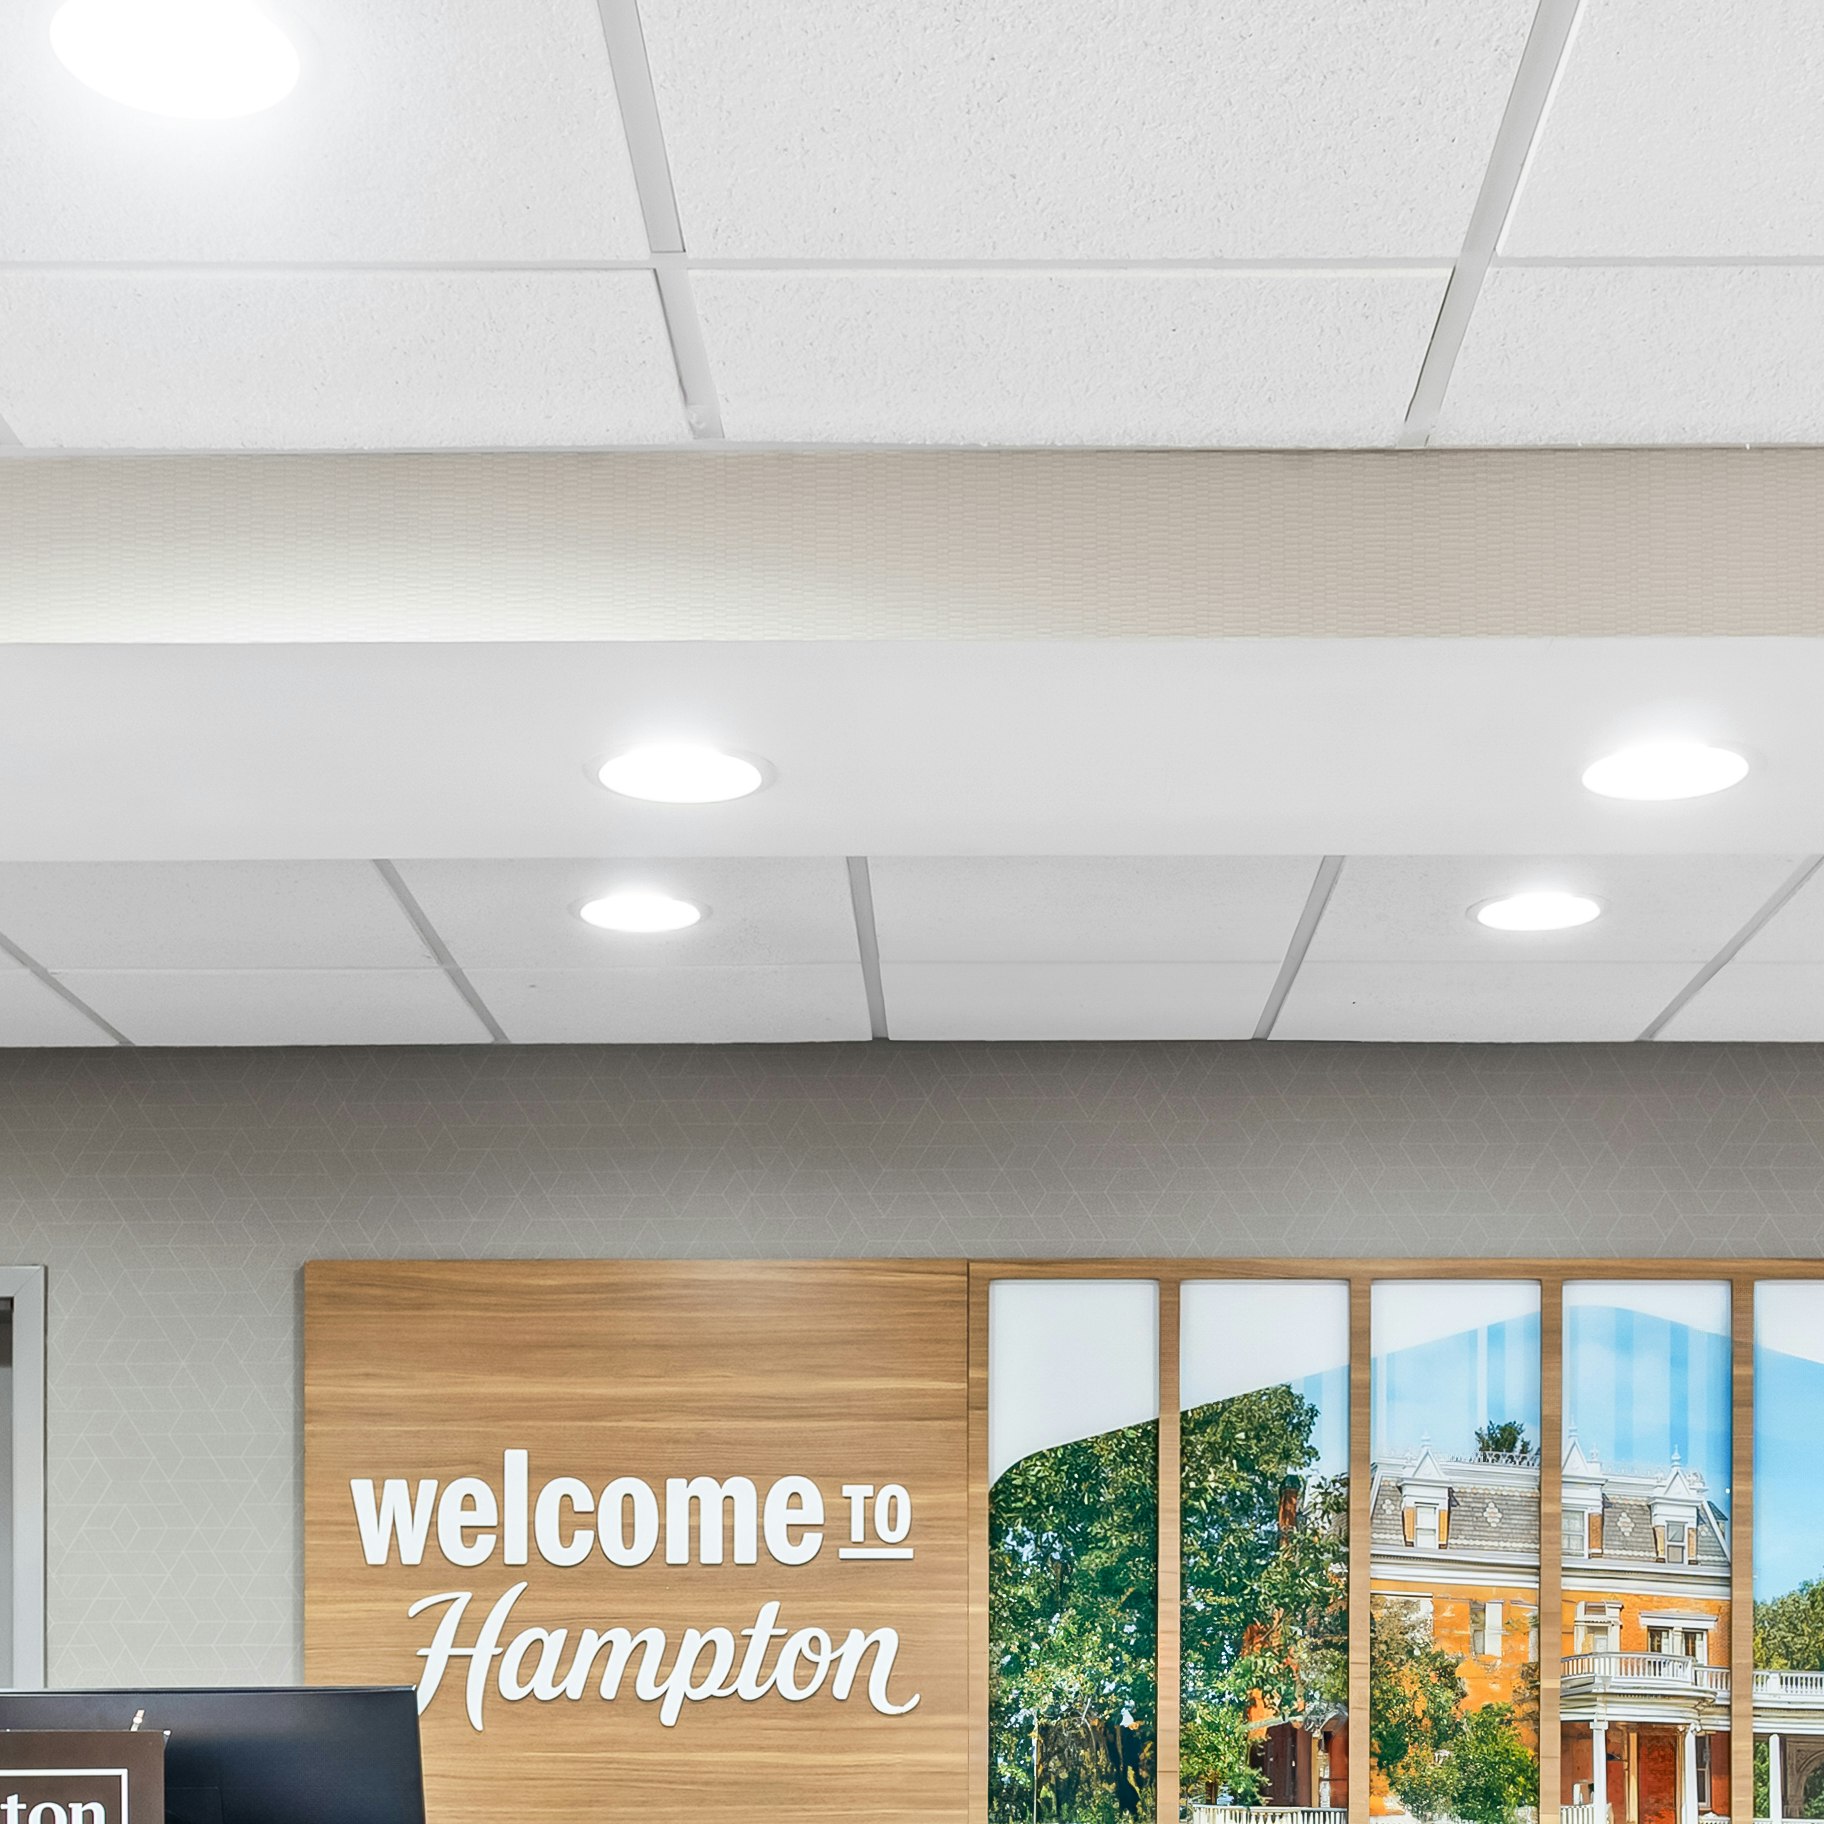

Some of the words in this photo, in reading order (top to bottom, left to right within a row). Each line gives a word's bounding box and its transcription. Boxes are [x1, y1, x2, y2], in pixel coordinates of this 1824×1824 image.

[350, 1449, 825, 1567] welcome
[842, 1484, 912, 1543] TO
[408, 1582, 920, 1731] Hampton
